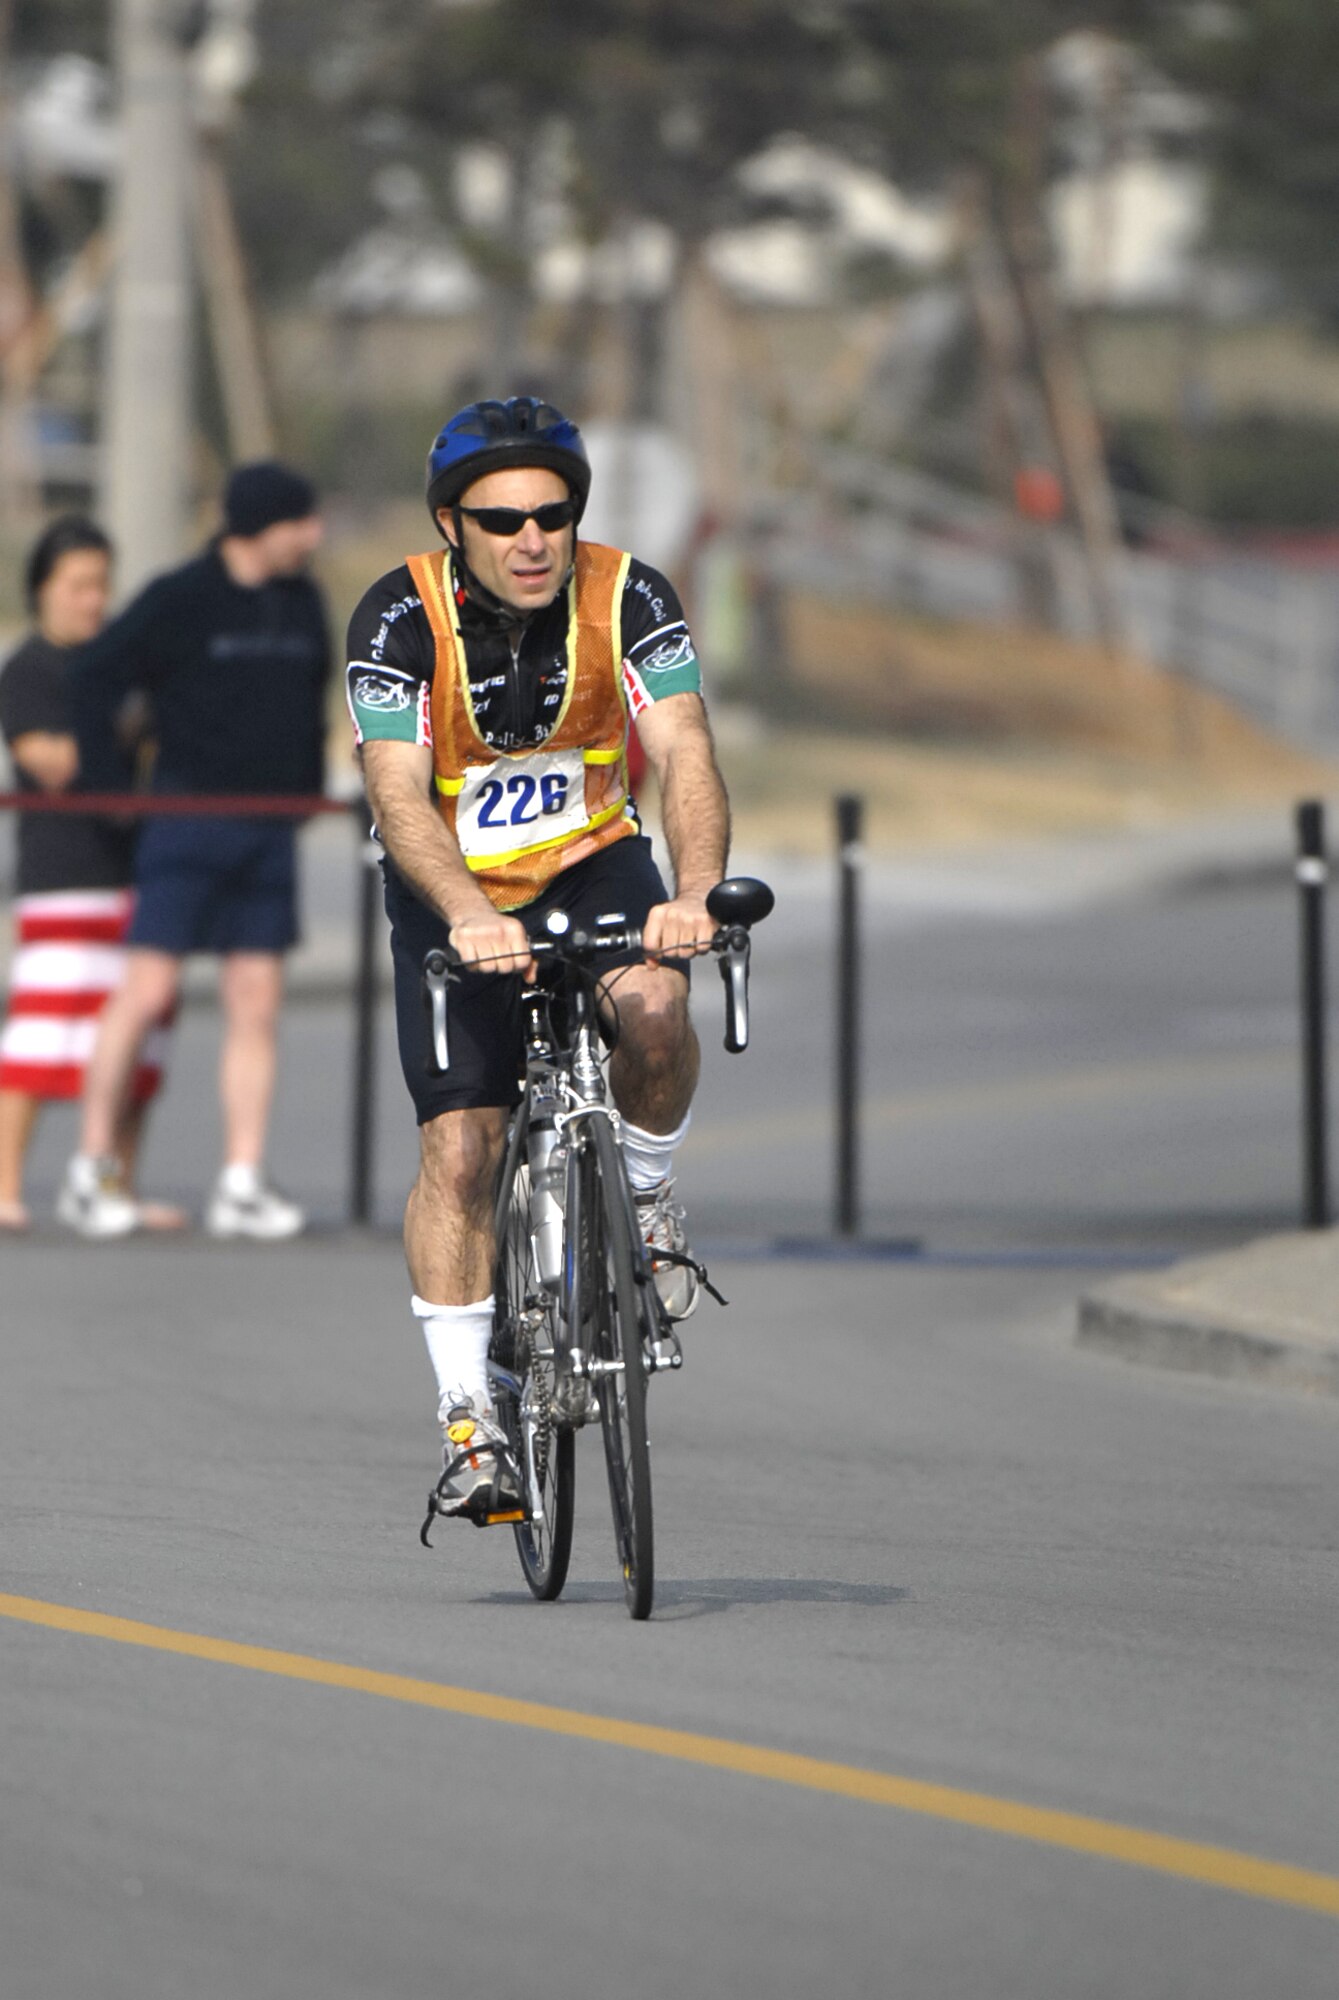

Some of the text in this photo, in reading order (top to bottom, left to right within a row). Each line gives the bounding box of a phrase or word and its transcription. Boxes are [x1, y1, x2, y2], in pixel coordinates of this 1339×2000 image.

[370, 622, 389, 649] Beer
[381, 602, 408, 623] Belly
[475, 774, 569, 829] 226
